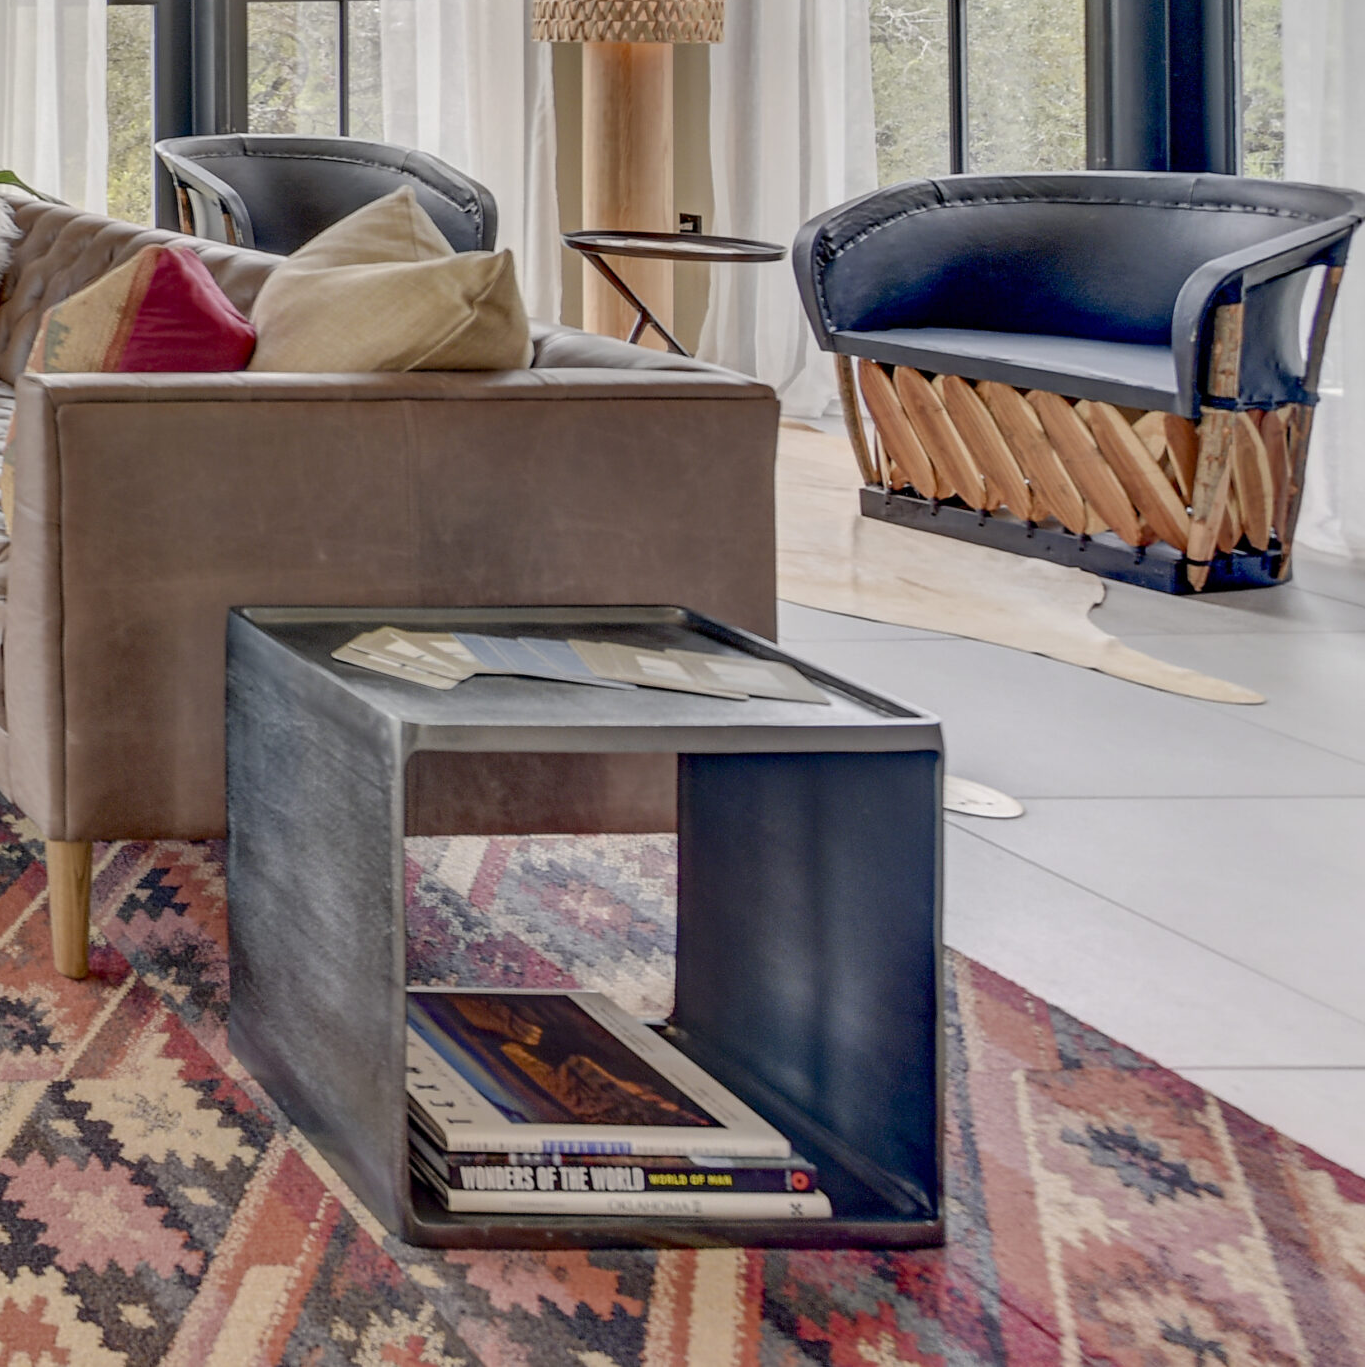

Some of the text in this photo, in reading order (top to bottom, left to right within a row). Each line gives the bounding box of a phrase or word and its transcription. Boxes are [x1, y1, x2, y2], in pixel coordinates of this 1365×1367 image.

[459, 1166, 645, 1191] WONDERS OF THE WORLD
[648, 1174, 733, 1186] WORLD OF MAN
